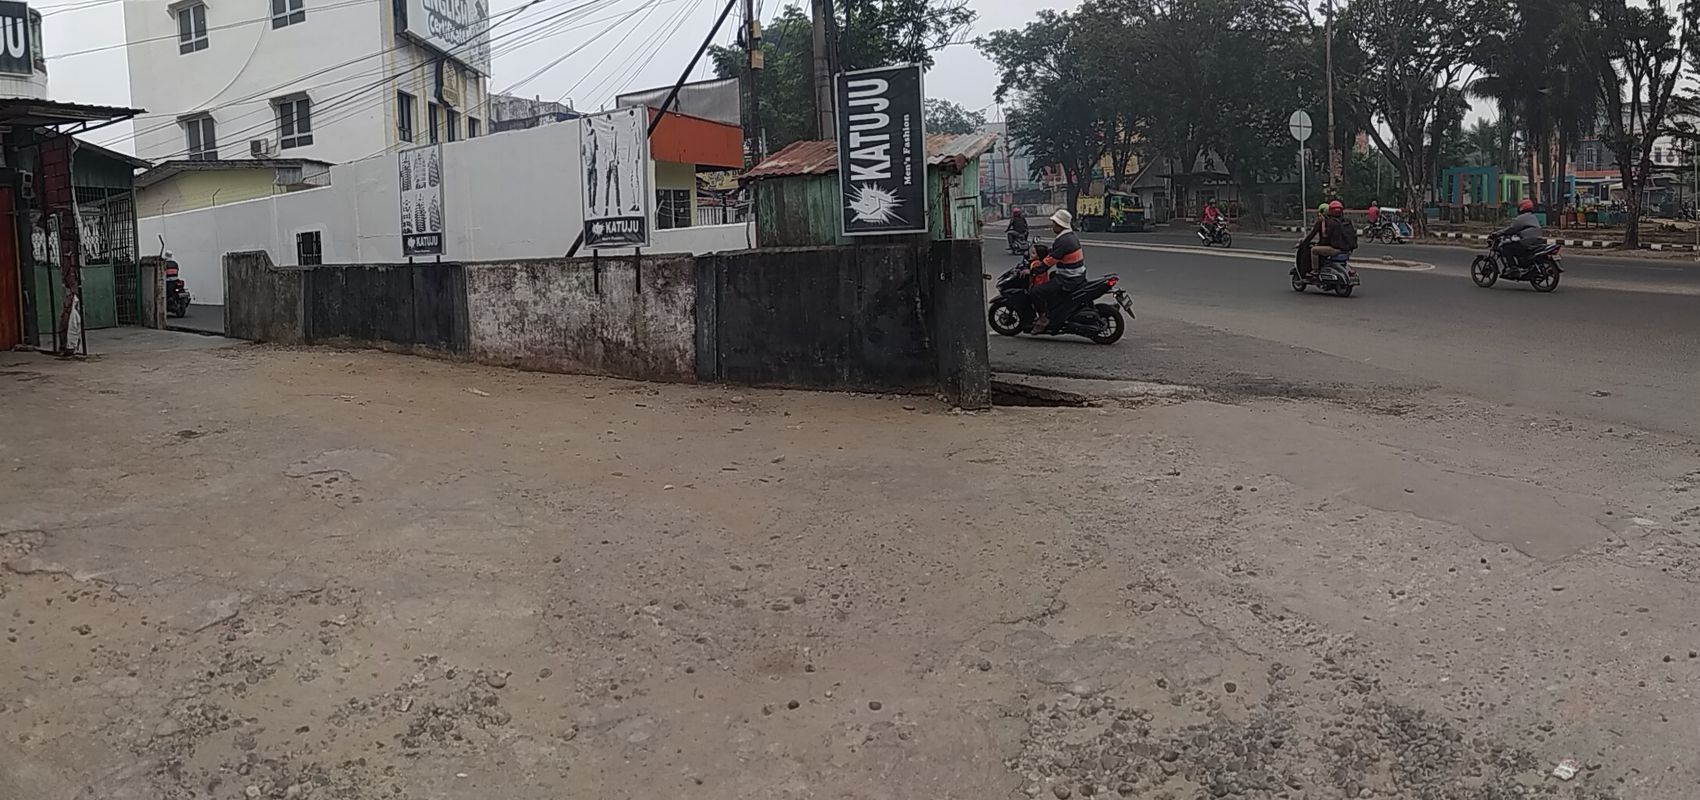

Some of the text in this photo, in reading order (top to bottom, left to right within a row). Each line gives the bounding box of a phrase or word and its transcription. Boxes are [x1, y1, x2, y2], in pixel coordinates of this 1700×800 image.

[847, 78, 892, 181] KATUJU
[902, 114, 912, 185] Men's Fashion
[416, 235, 438, 247] KATUJU
[605, 220, 639, 234] KATUJU
